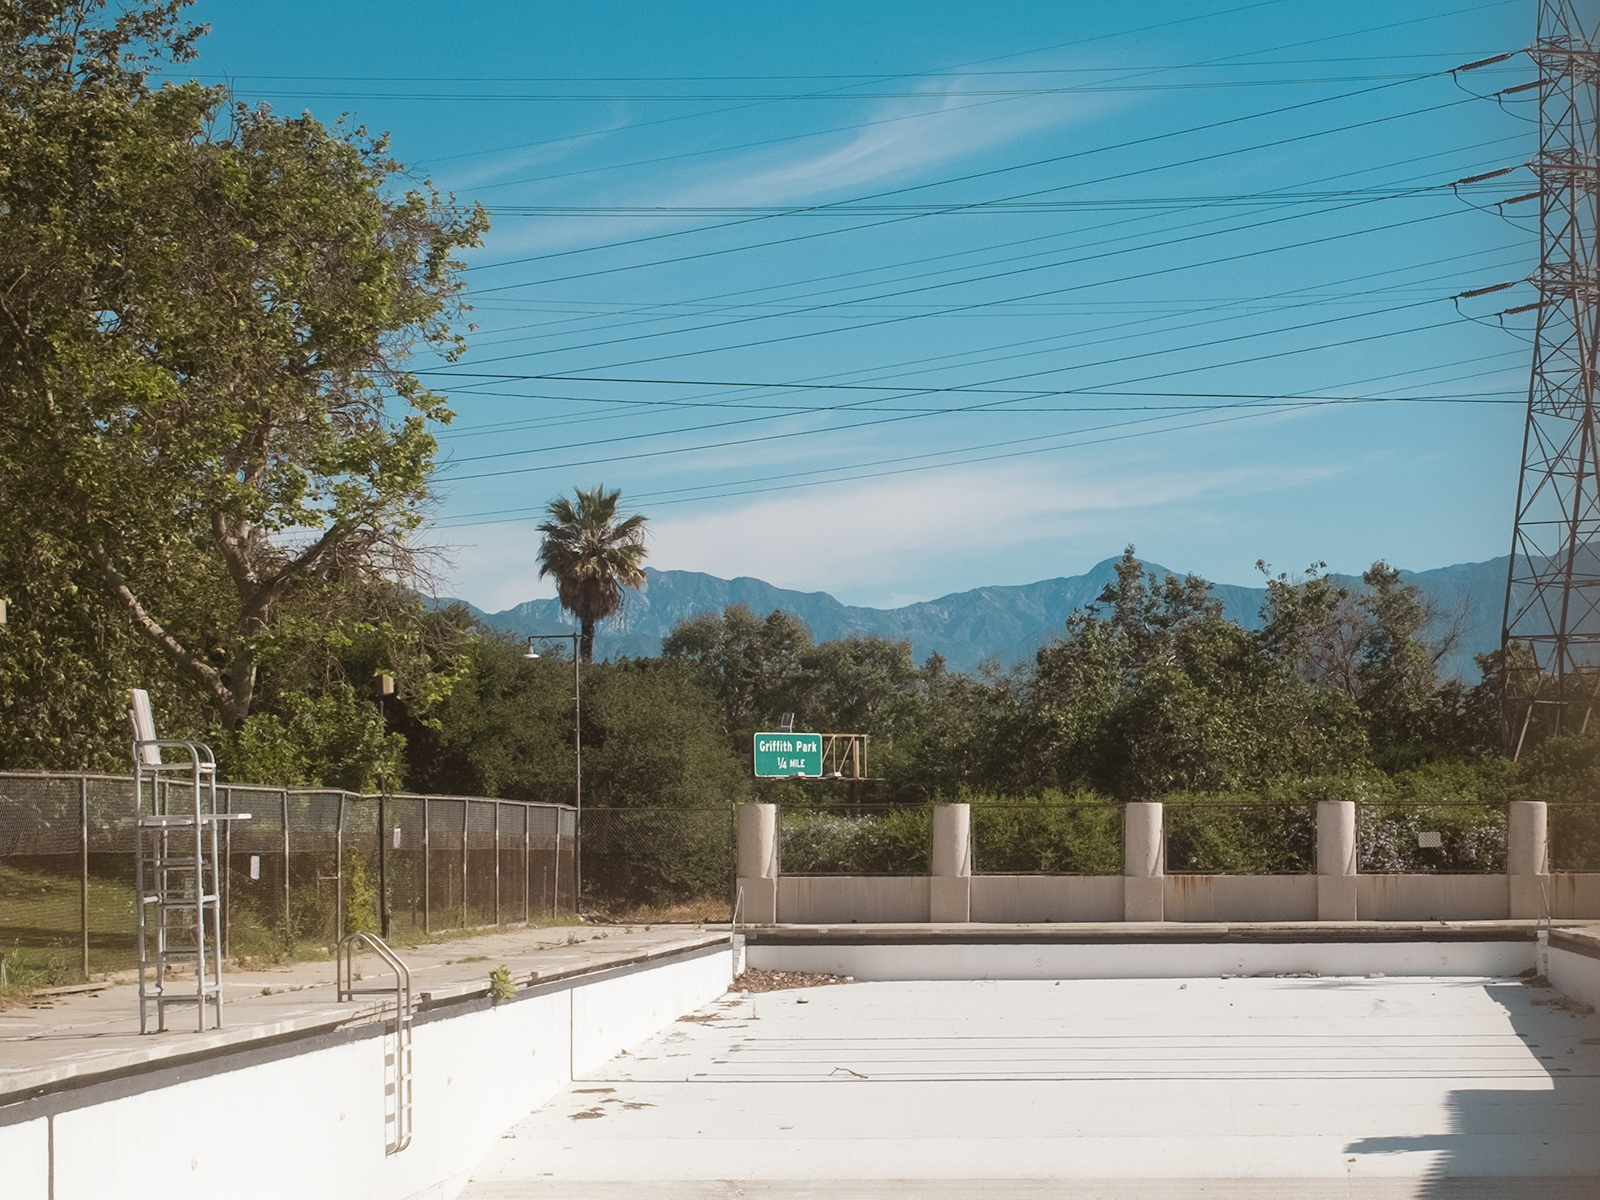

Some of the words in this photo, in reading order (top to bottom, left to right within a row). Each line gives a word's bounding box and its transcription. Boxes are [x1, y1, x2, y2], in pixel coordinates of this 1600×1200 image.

[759, 740, 793, 753] Griffith
[796, 740, 818, 753] Park
[789, 758, 806, 769] MILE
